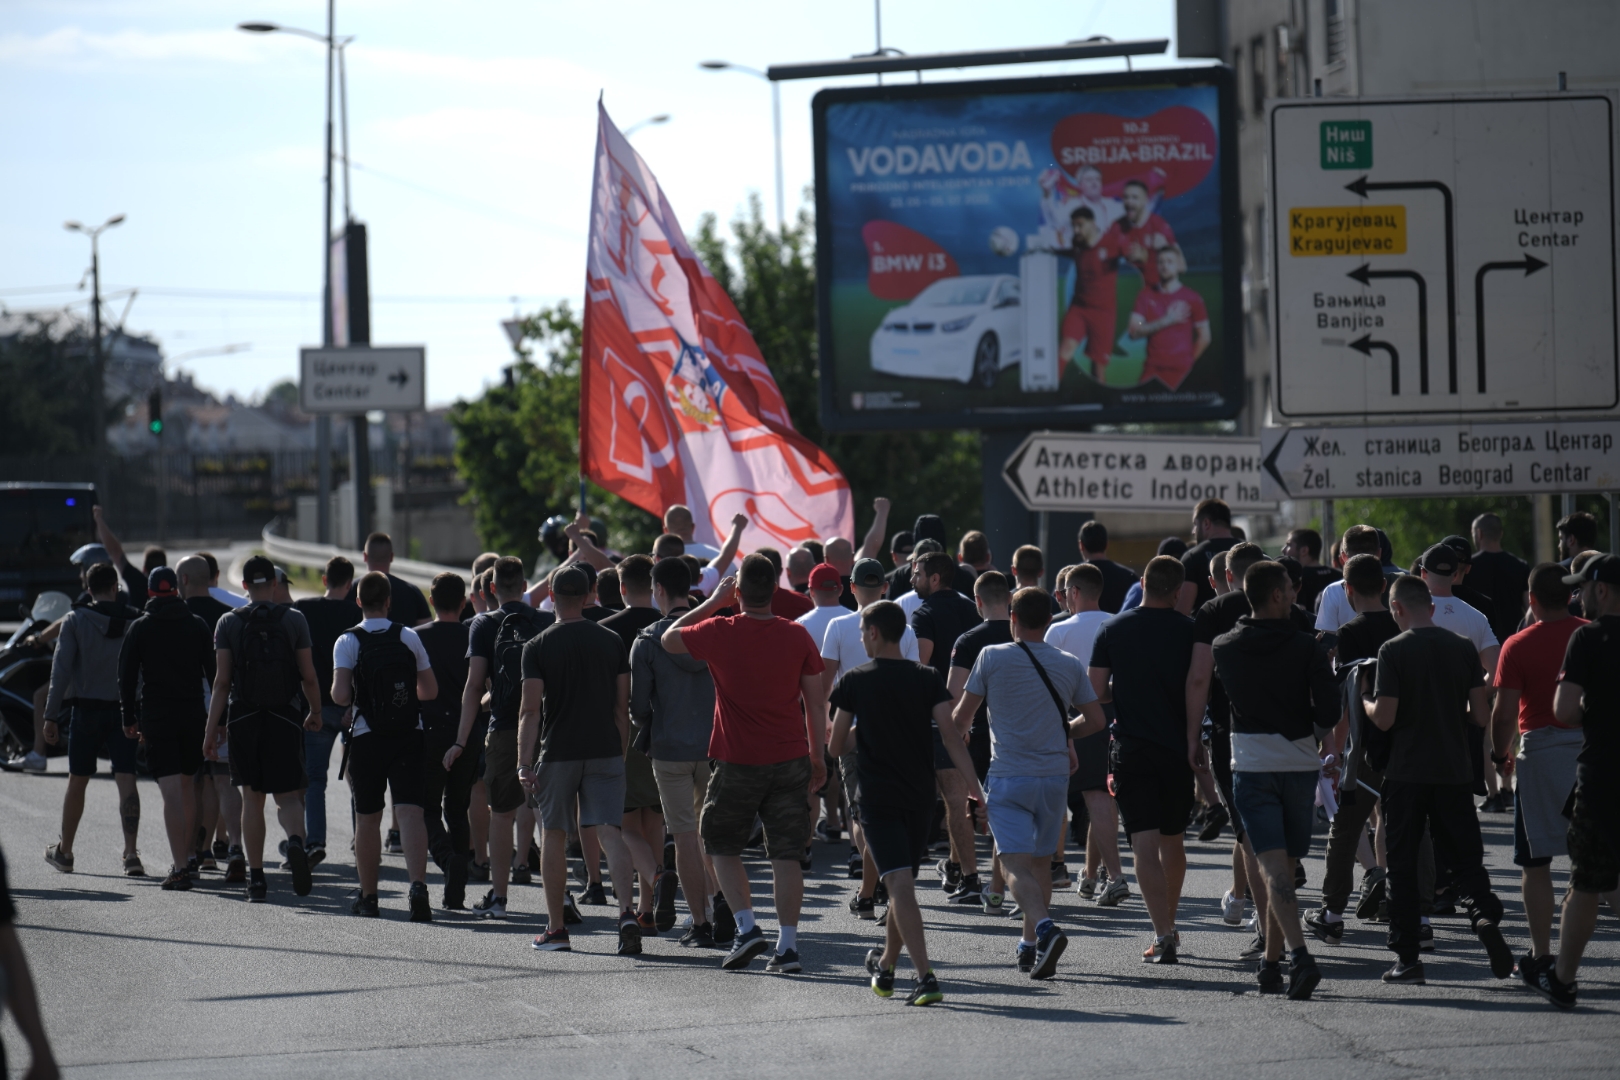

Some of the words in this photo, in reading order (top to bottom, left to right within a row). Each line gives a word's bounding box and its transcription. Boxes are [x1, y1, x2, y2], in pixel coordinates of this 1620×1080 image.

[1326, 126, 1365, 142] Ниш
[846, 139, 1034, 177] VODAVODA
[1060, 142, 1213, 165] SRBIJA-BRAZIL
[1327, 146, 1355, 163] Niš
[1292, 211, 1397, 232] Крагујевац
[1514, 208, 1584, 227] Центар
[1293, 234, 1393, 255] Kragujevac
[1518, 231, 1579, 247] Centar
[872, 254, 924, 273] BMW
[1314, 292, 1386, 310] Бањица
[1317, 311, 1384, 332] Banjica
[313, 381, 370, 401] Centar
[1303, 436, 1346, 457] Жел.
[1365, 437, 1441, 456] станица
[1459, 432, 1536, 457] Београд
[1546, 430, 1613, 455] Центар
[1035, 446, 1147, 471] Атлетска
[1163, 453, 1261, 477] дворан
[1303, 463, 1336, 489] Žel.
[1356, 466, 1422, 488] stanica
[1439, 463, 1514, 490] Beograd
[1530, 462, 1591, 484] Centar
[1035, 476, 1133, 499] Athletic
[1152, 478, 1228, 500] Indoor
